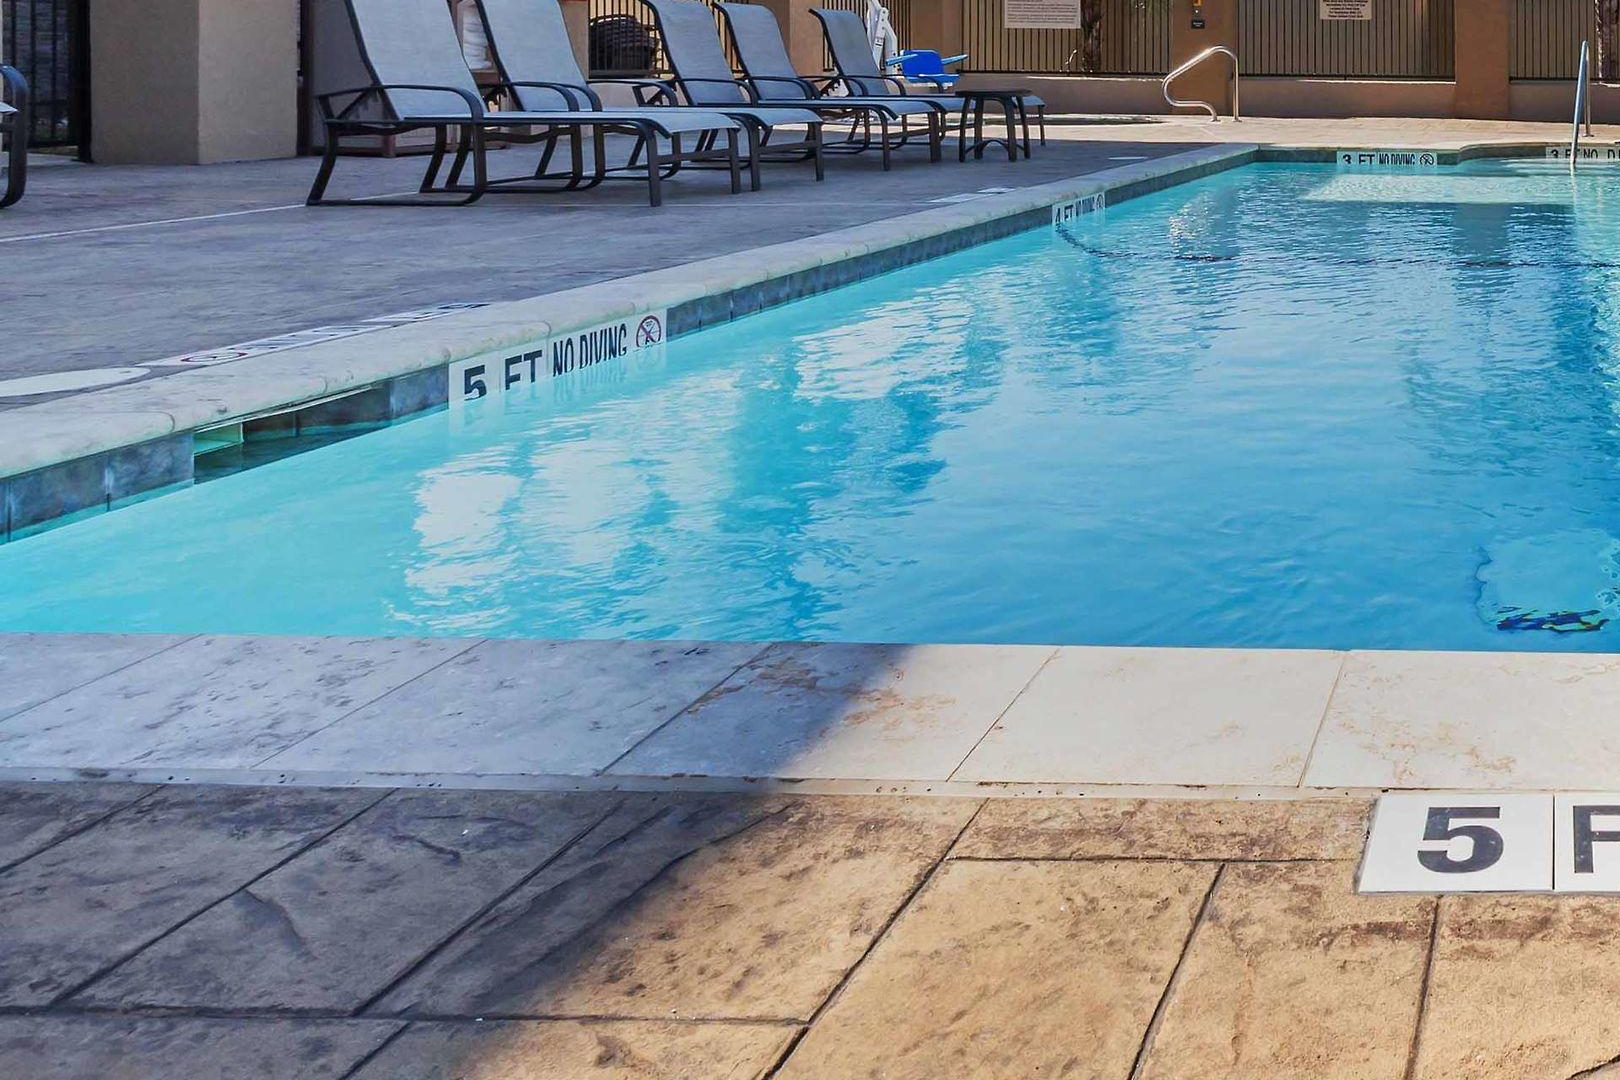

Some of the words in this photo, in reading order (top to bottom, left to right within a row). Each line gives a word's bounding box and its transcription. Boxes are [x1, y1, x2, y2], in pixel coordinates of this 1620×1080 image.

[1342, 154, 1352, 165] 3
[1358, 153, 1375, 165] FT
[1583, 150, 1598, 159] NO
[464, 364, 487, 401] 5
[505, 350, 543, 390] FT
[552, 338, 574, 377] NO
[579, 323, 627, 369] DIVING
[1417, 806, 1504, 873] 5
